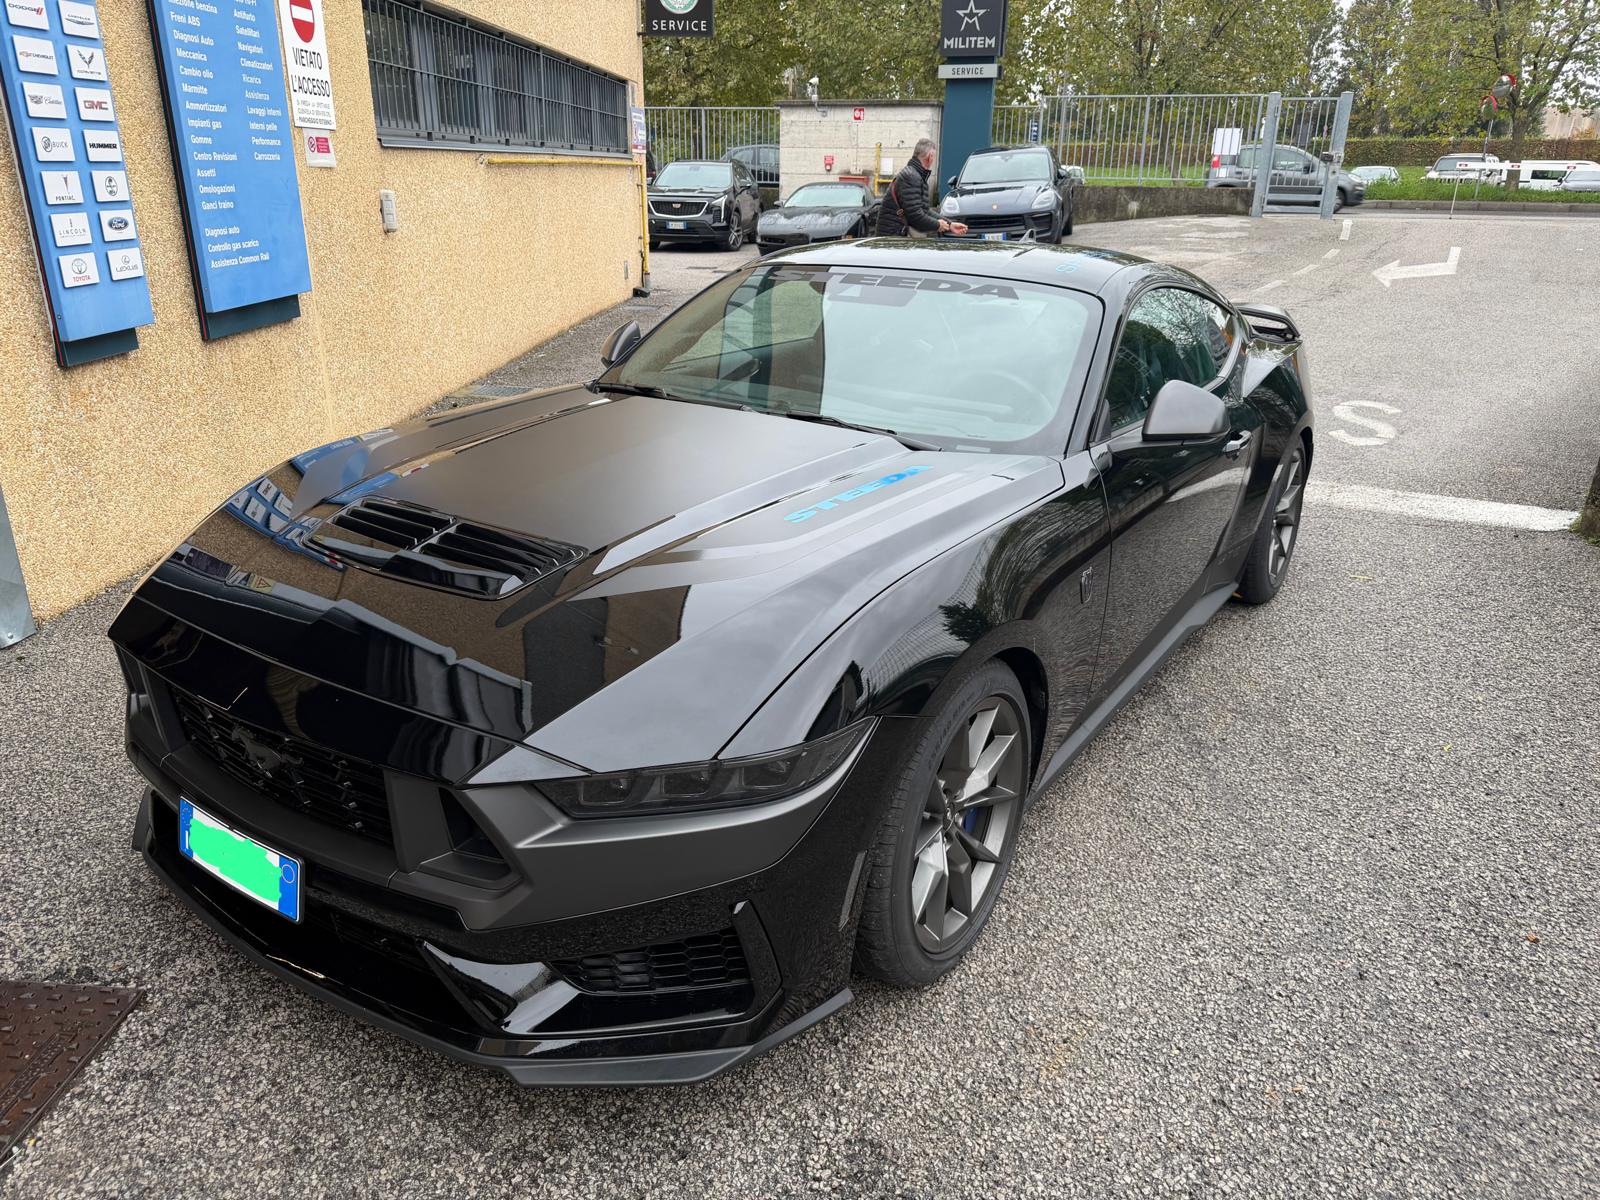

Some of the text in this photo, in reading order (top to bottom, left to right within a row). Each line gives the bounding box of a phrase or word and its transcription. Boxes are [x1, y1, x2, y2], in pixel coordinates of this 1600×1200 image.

[170, 11, 201, 27] Freni ABS
[652, 20, 707, 31] SERVICE
[173, 30, 214, 46] Diagnosi Auto
[943, 36, 996, 49] MILITEM
[176, 48, 208, 62] Meccanica
[292, 47, 322, 70] VIETATO
[180, 65, 214, 79] Cambio olio
[951, 67, 985, 76] SERVICE
[182, 83, 208, 95] Marmitte
[291, 74, 331, 98] L'ACCESSO
[83, 100, 109, 111] GMC
[185, 101, 228, 113] Ammortizzatori
[188, 118, 222, 131] Impianti gas
[191, 135, 213, 145] Gomme
[193, 152, 238, 161] Centro Revisioni
[197, 168, 217, 177] Assetti
[199, 184, 236, 195] Omologazioni
[202, 200, 234, 210] Ganci traino
[205, 226, 240, 238] Diagnosi auto
[208, 239, 260, 253] Controllo gas scarico
[211, 252, 270, 269] Assistenza Common Rail
[72, 275, 92, 283] TOYOTA
[768, 269, 1021, 301] STEEDA
[783, 465, 934, 523] STEEDA
